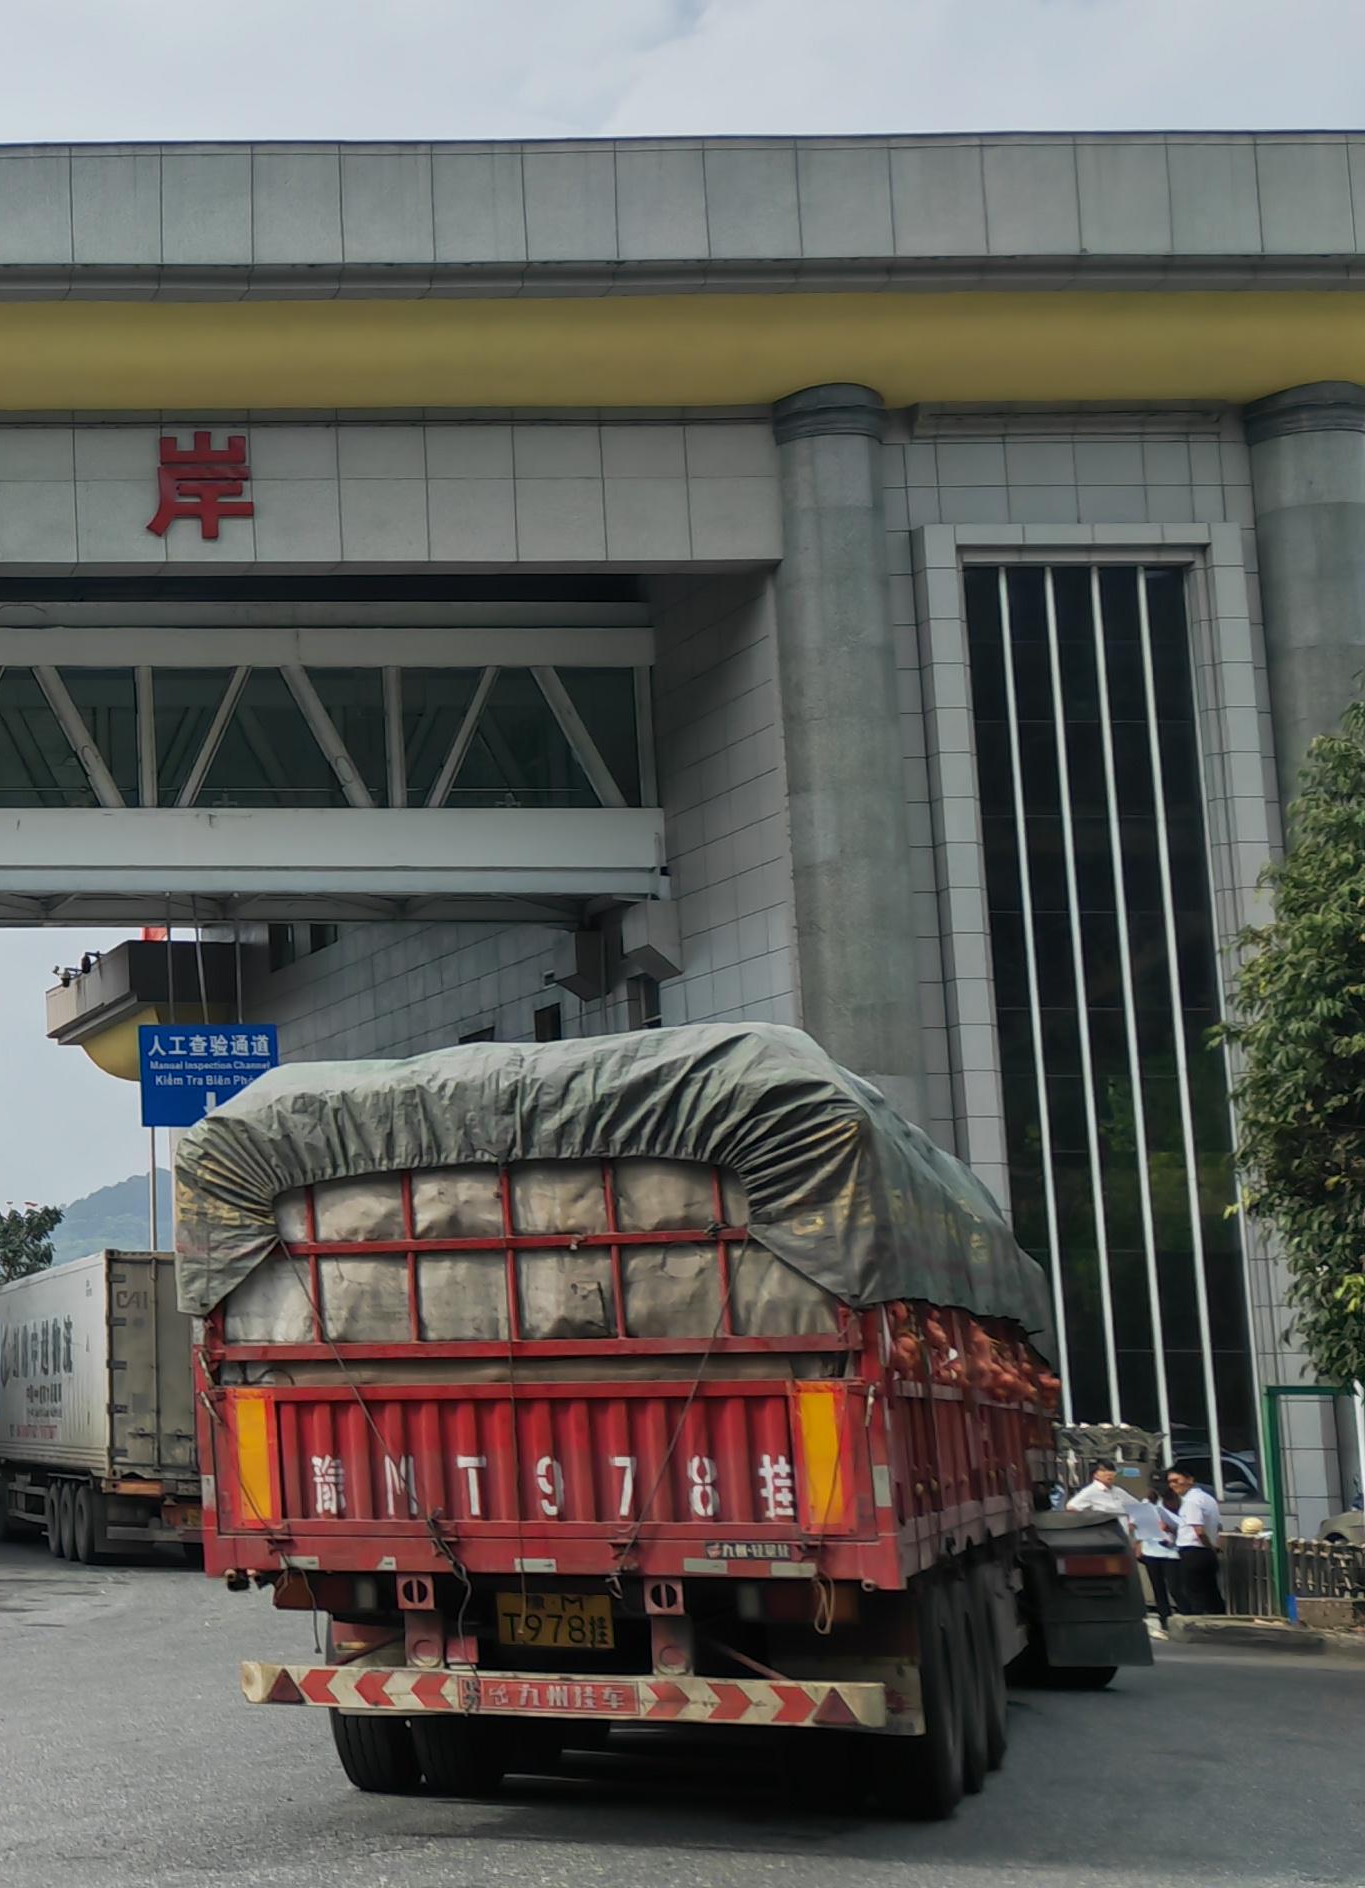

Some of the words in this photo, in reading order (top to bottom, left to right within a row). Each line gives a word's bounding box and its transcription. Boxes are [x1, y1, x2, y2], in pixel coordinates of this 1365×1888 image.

[148, 1034, 270, 1057] 人工查验通道
[150, 1061, 183, 1070] Manual
[185, 1061, 231, 1072] Inspection
[186, 1075, 204, 1086] Tra
